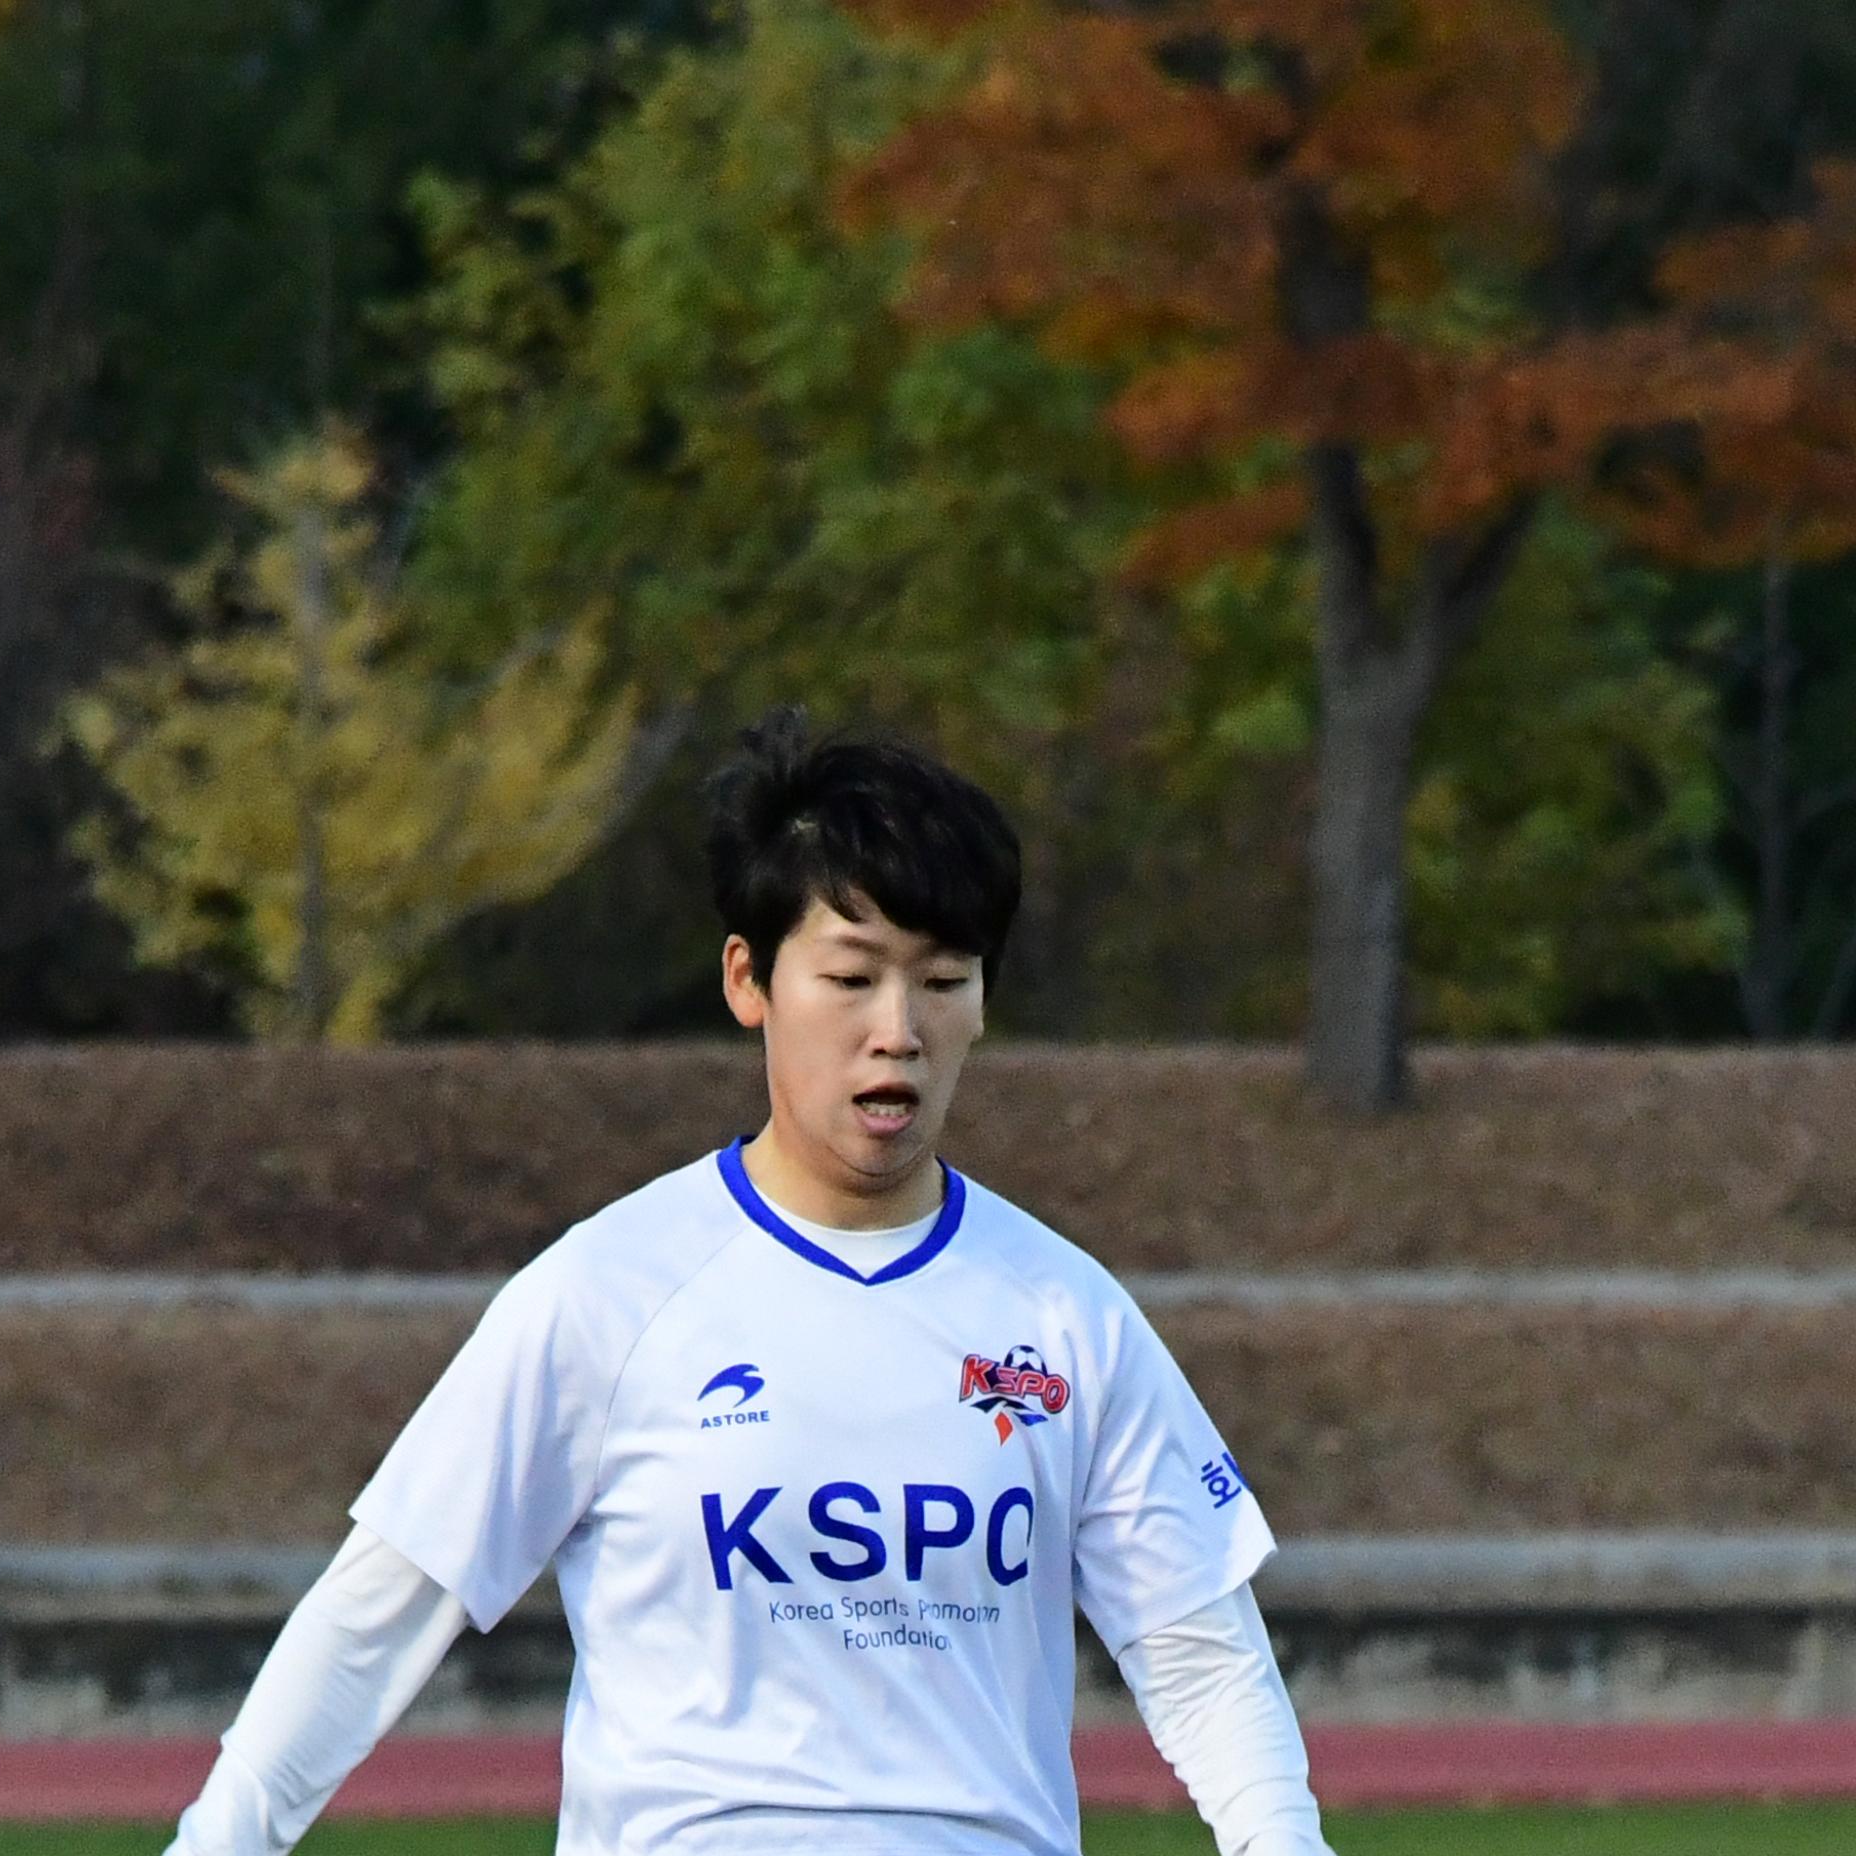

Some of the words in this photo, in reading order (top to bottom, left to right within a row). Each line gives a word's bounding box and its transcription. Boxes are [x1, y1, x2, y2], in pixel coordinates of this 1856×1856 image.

[959, 1353, 1070, 1414] KSPO
[701, 1410, 770, 1429] ASTORE
[769, 1600, 834, 1623] Korea
[841, 1596, 909, 1622] Sports
[843, 1624, 952, 1650] Foundatio
